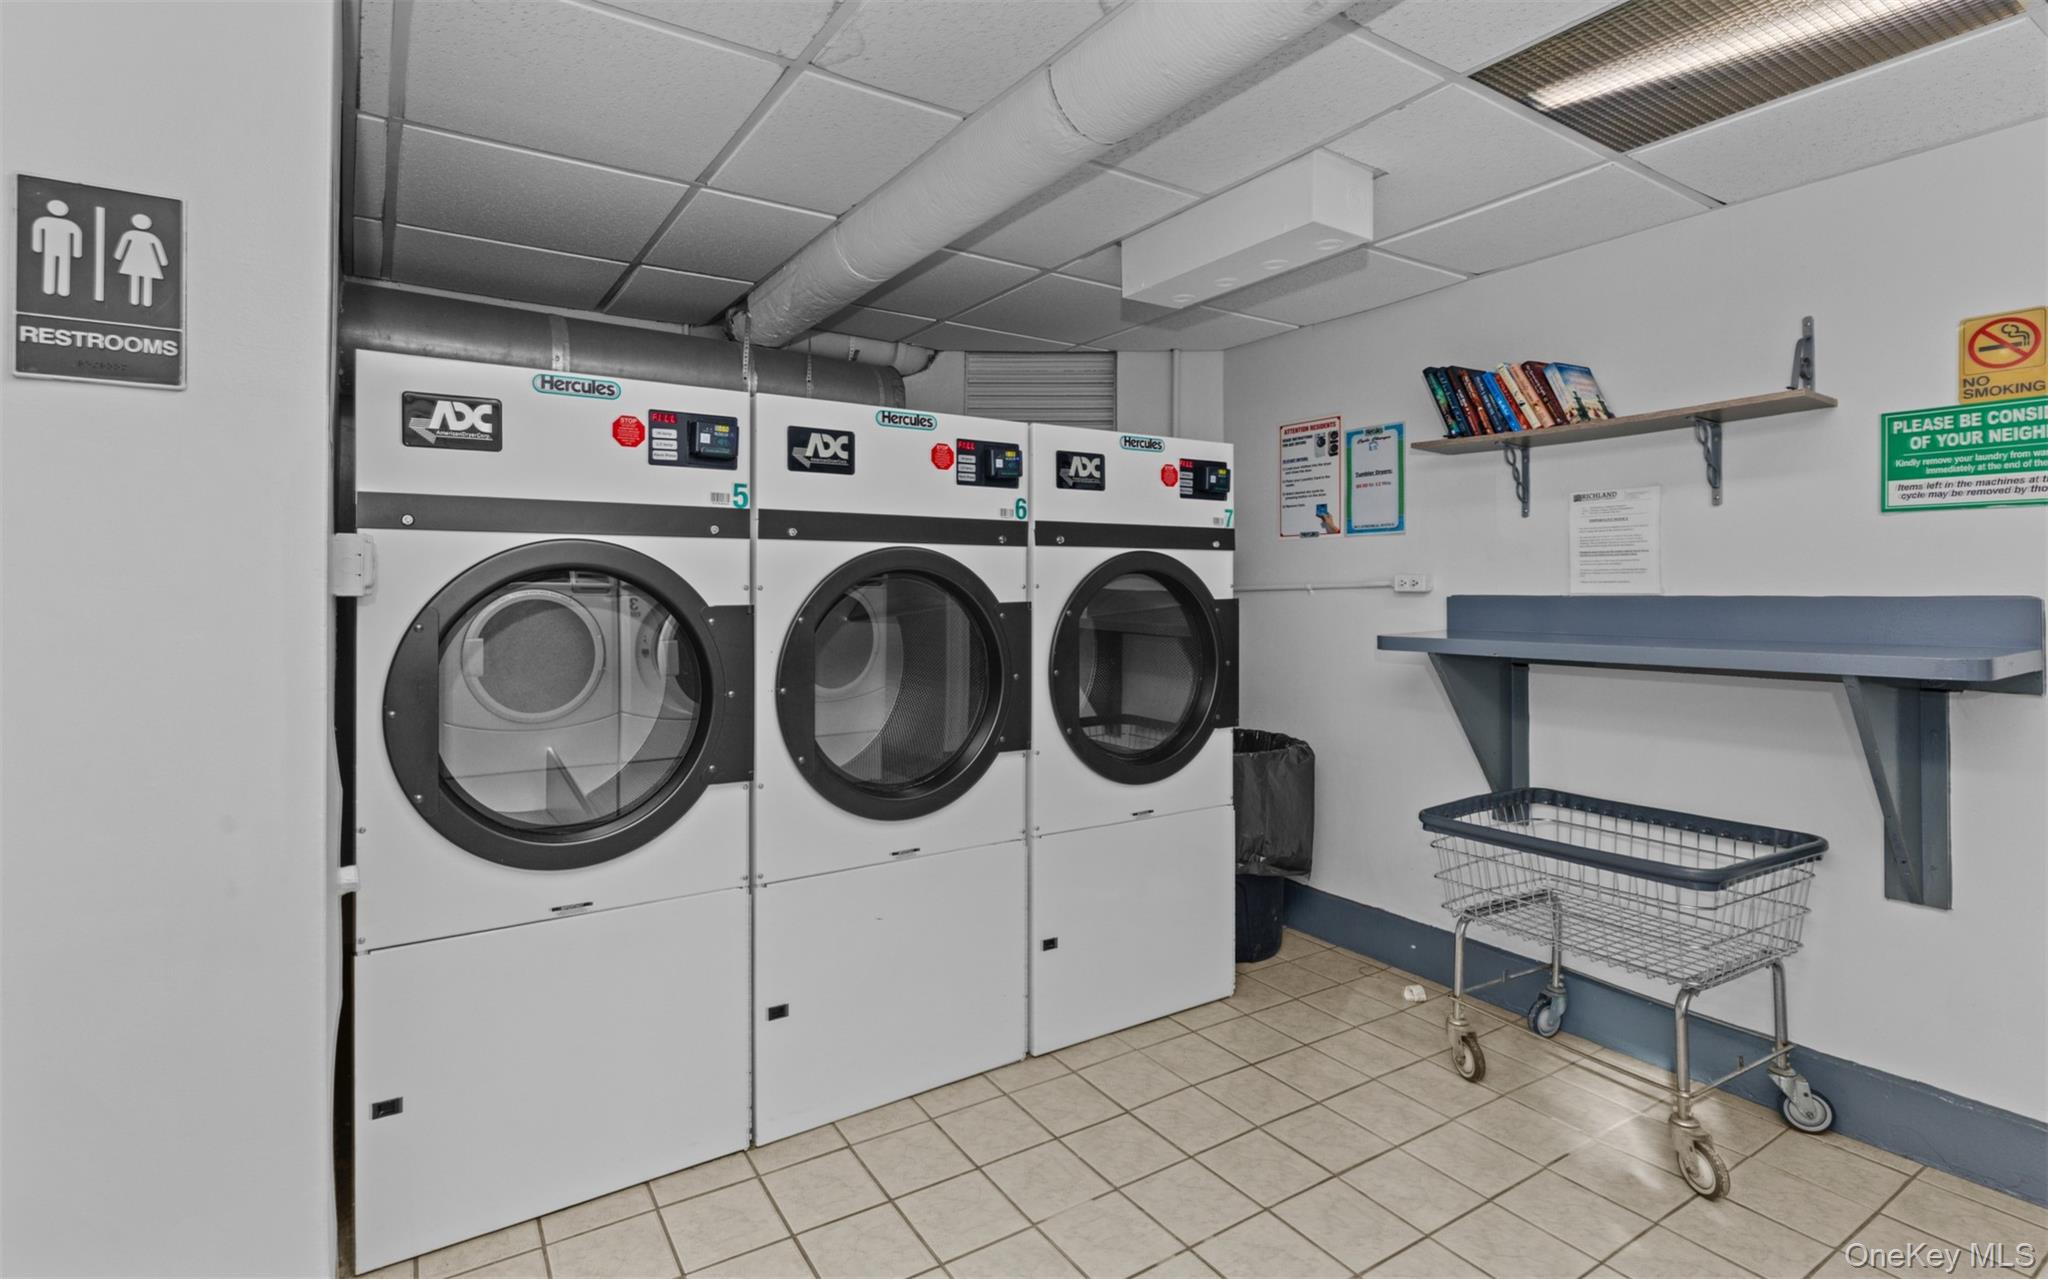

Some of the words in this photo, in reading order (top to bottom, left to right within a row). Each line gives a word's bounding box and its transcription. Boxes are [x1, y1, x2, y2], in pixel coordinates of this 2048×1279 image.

[19, 325, 178, 356] RESTROOMS
[540, 375, 616, 396] Hercules
[1963, 375, 1990, 388] NO
[1963, 380, 2046, 399] SMOKING
[428, 400, 493, 433] ADC
[881, 409, 934, 428] Hercules
[1892, 415, 1954, 434] PLEASE
[1959, 412, 1982, 428] BE
[804, 432, 849, 460] ADC
[1123, 436, 1163, 450] Hercules
[1910, 435, 1931, 449] OF
[1936, 430, 1983, 447] YOUR
[1988, 424, 2048, 443] NEIGH
[1069, 455, 1101, 478] ADC
[1895, 458, 1920, 468] Kindly
[1922, 456, 1952, 466] remove
[1954, 455, 1974, 464] your
[1975, 453, 2008, 461] laundry
[2010, 450, 2031, 458] from
[1977, 463, 1986, 471] at
[1987, 462, 2001, 470] the
[2003, 460, 2020, 469] end
[2022, 459, 2032, 467] of
[1901, 491, 1925, 501] cycle
[1928, 491, 1949, 499] may
[1951, 489, 1964, 497] be
[1966, 486, 2011, 495] removed
[2014, 485, 2027, 495] by
[1926, 481, 1942, 489] left
[1975, 477, 2025, 486] machines
[733, 482, 749, 509] 5
[1015, 498, 1028, 520] 6
[1224, 508, 1234, 528] 7
